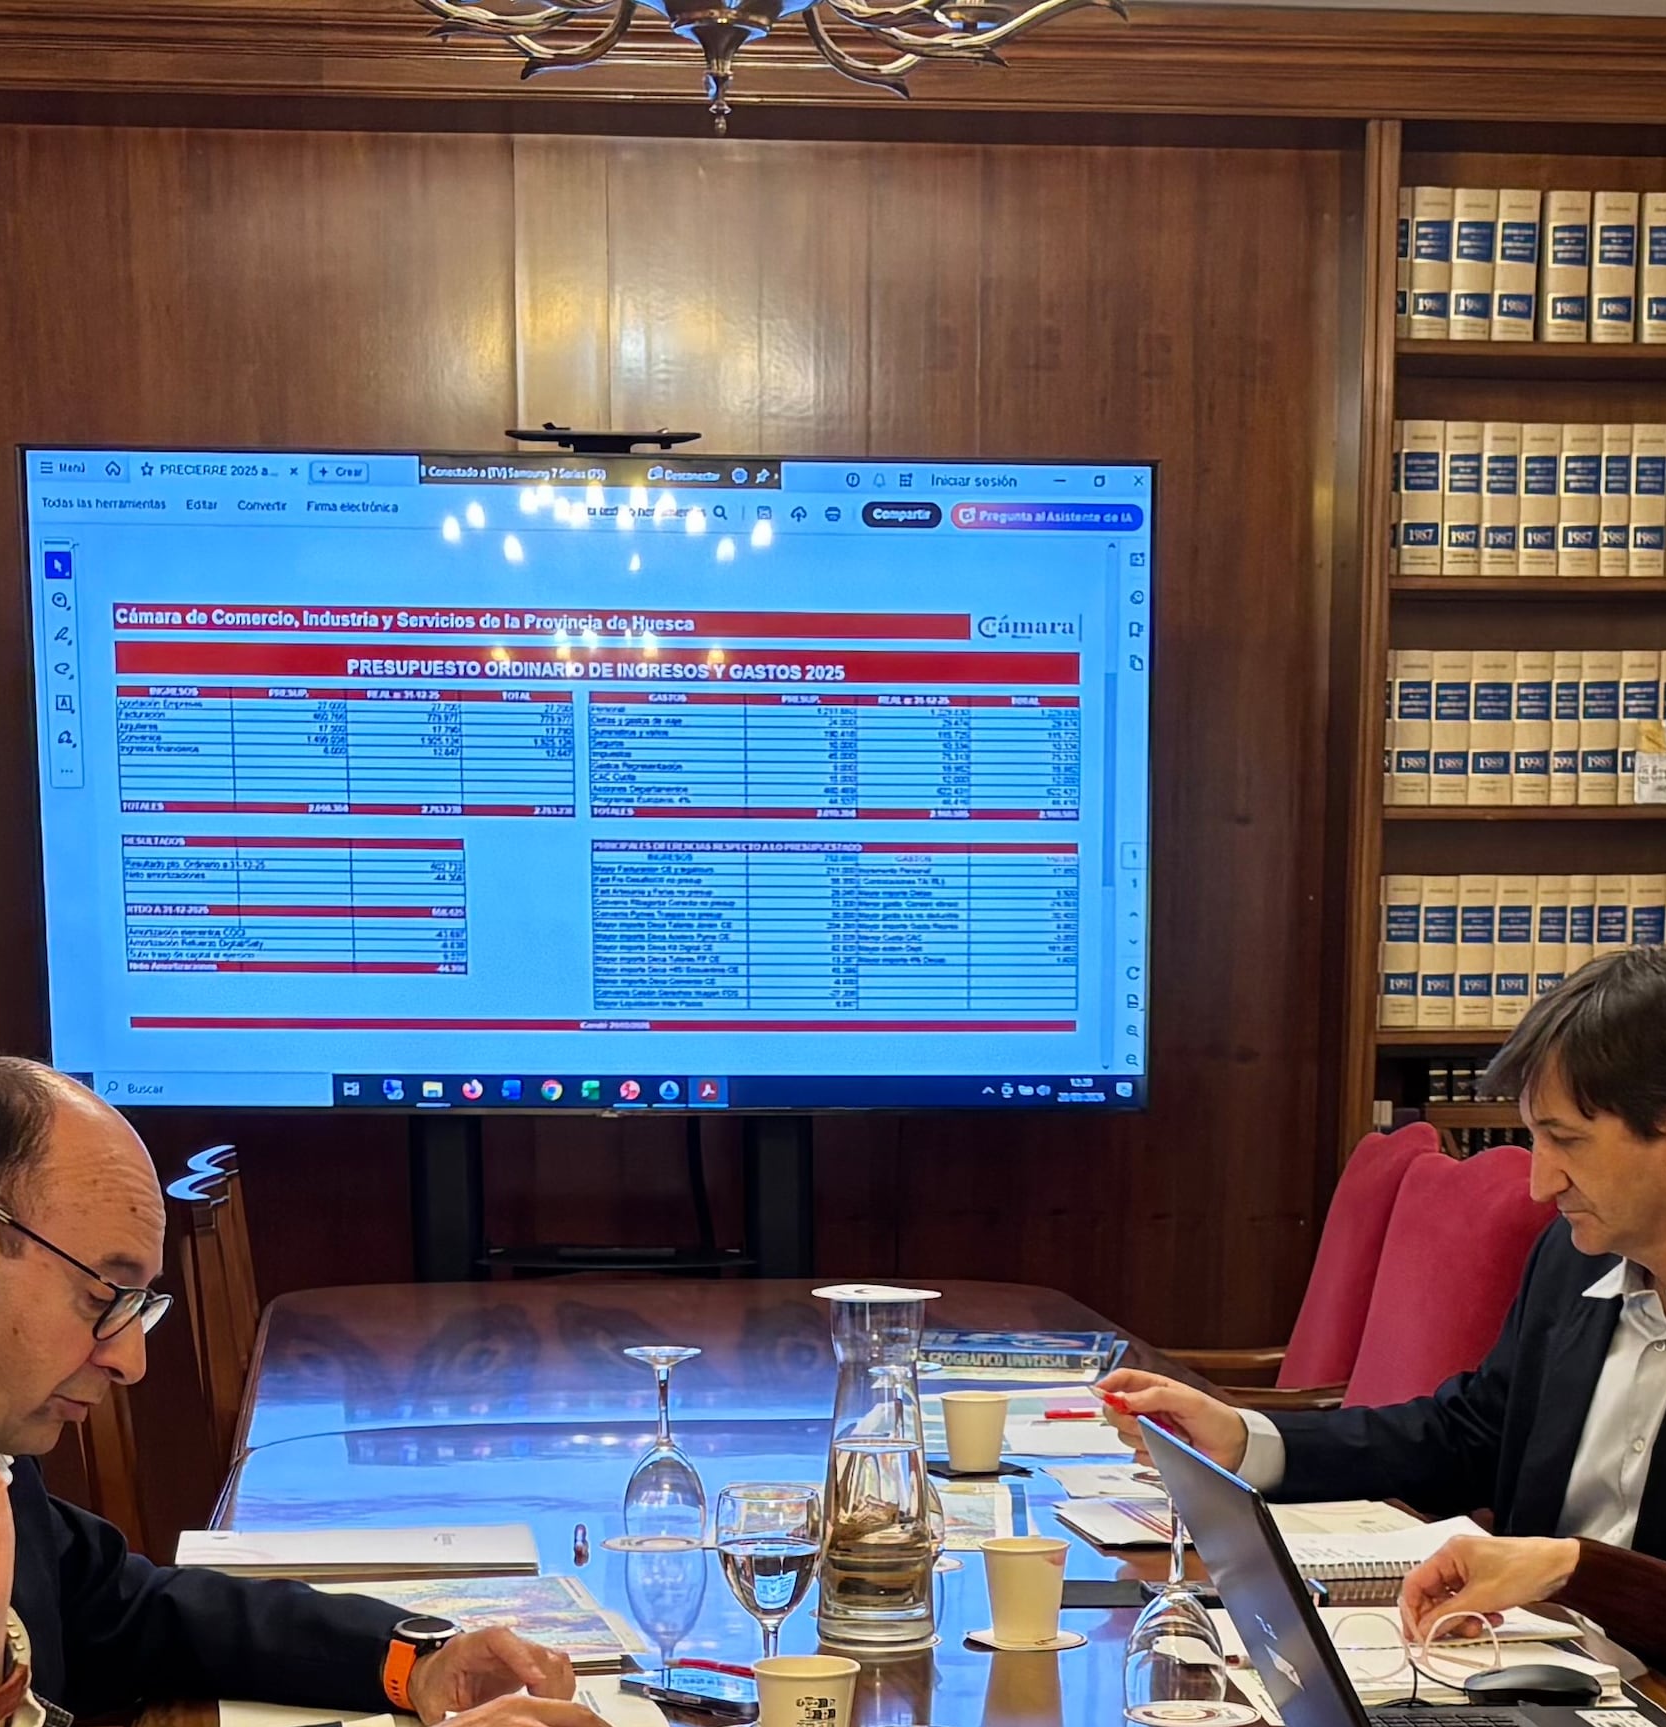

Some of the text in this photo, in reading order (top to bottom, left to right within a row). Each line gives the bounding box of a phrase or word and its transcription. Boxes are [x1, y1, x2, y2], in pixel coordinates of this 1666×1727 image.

[160, 465, 257, 477] PRECIERRE 2025
[335, 467, 361, 477] Crear
[932, 474, 1017, 488] Iniciar sesión
[42, 497, 166, 511] Todas las herramientas
[186, 499, 217, 511] Editar
[237, 500, 286, 512] Convertir
[307, 501, 398, 514] Firma electrónica
[872, 509, 931, 522] Compartir
[980, 510, 1032, 524] Pregunta
[1034, 511, 1044, 522] al
[1047, 511, 1101, 523] Asistente
[1103, 512, 1118, 523] de
[1409, 529, 1435, 541] 1987
[1451, 531, 1476, 543] 1987
[1488, 532, 1513, 545] 1987
[1527, 532, 1552, 545] 1987
[1568, 531, 1593, 544] 1987
[115, 609, 694, 632] Cámara de Comercio, Industria y Servicios de la Provincia de Huesca
[978, 614, 1075, 638] Cámara
[347, 659, 845, 681] PRESUPUESTO ORDINARIO DE INGRESOS Y GASTOS 2025
[1390, 978, 1413, 990] 1991
[1427, 979, 1450, 991] 1991
[1465, 979, 1487, 991] 1991
[1501, 978, 1524, 991] 1991
[128, 1084, 163, 1094] Buscar
[1006, 1353, 1069, 1368] UNIVERSAL
